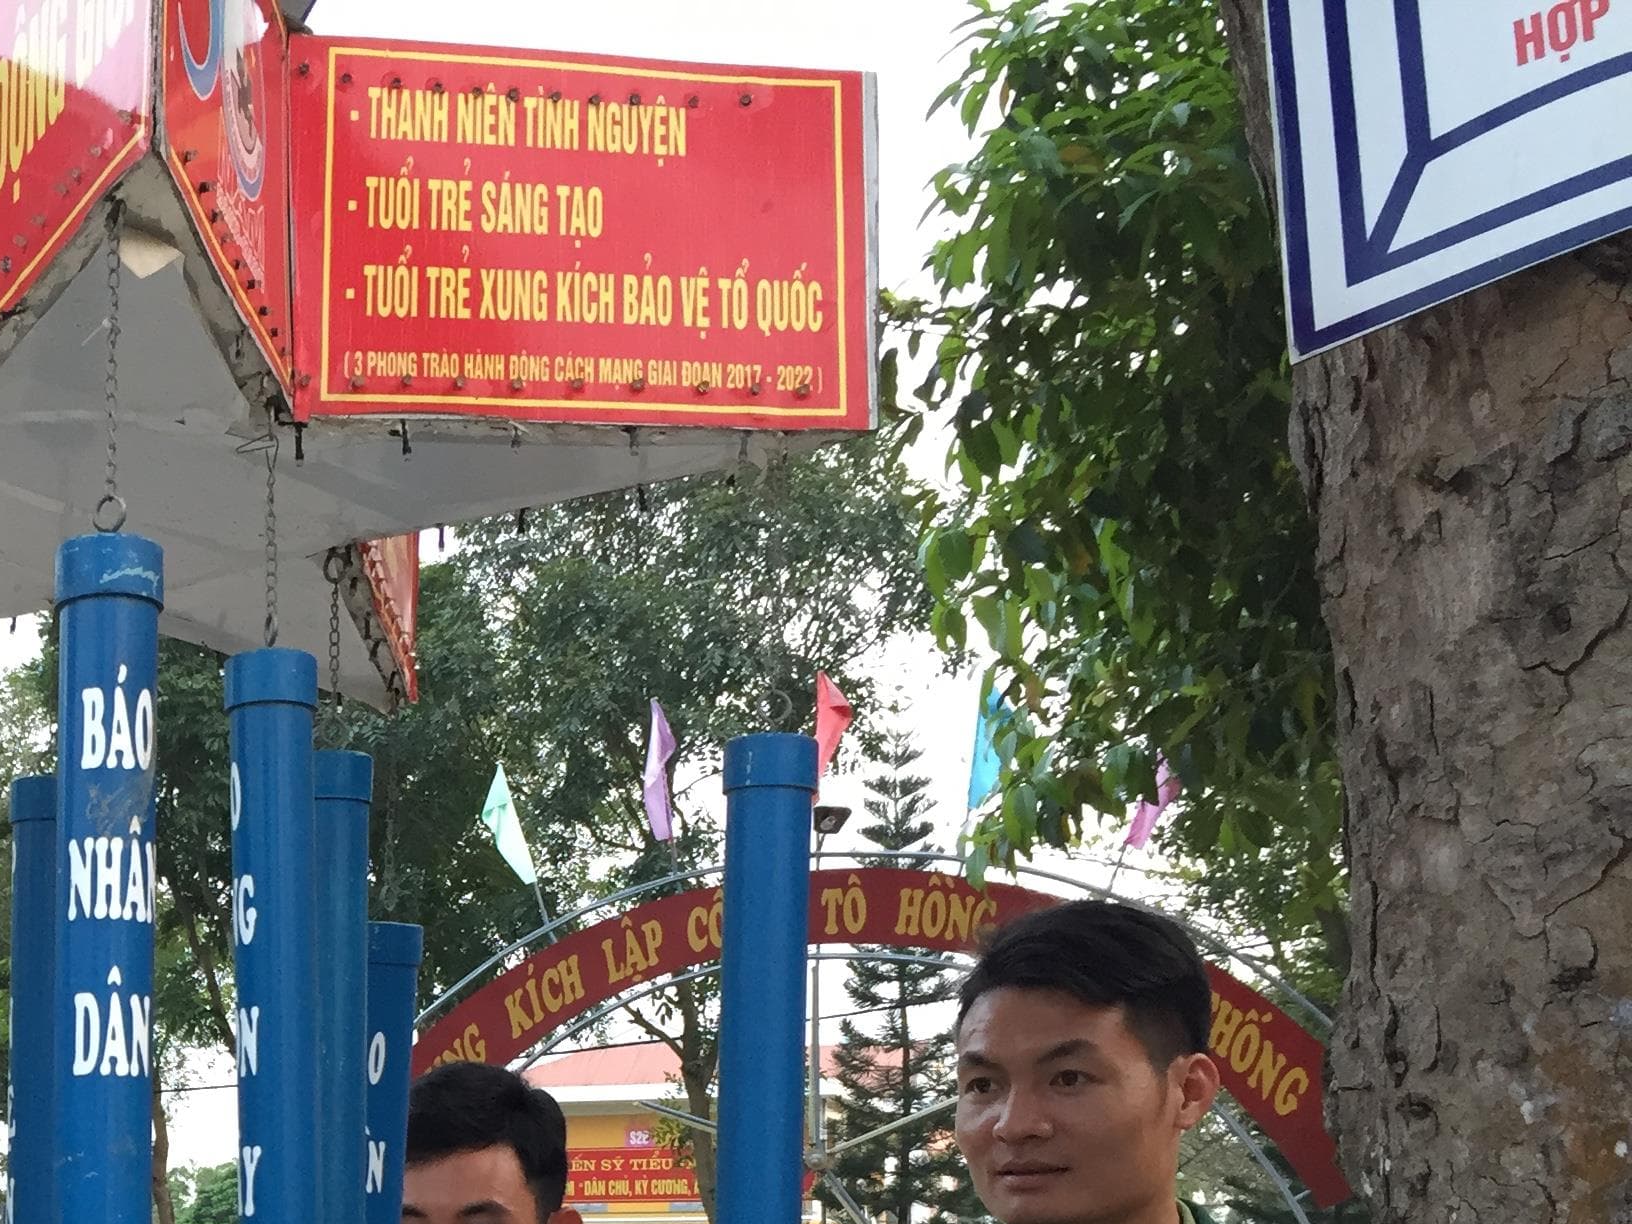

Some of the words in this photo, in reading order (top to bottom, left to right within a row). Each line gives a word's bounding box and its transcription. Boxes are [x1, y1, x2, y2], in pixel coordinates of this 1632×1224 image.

[368, 86, 449, 143] THANH
[457, 82, 516, 146] NIÊN
[524, 85, 580, 151] TÌNH
[587, 95, 687, 168] NGUYỆN
[366, 156, 420, 230] TUỔI
[428, 157, 473, 232] TRẺ
[480, 170, 549, 236] SÁNG
[556, 184, 604, 249] TẠO
[363, 244, 418, 318] TUỔI
[426, 244, 472, 320] TRẺ
[479, 268, 548, 322] XUNG
[556, 261, 615, 324] KÍCH
[623, 252, 673, 326] BẢO
[680, 266, 711, 340] VỆ
[718, 258, 749, 330] TỔ
[756, 262, 824, 337] QUỐC
[368, 351, 418, 377] PHONG
[422, 347, 459, 378] TRÀO
[464, 348, 505, 380] HÀNH
[509, 350, 550, 387] ĐỘNG
[554, 351, 595, 384] CÁCH
[599, 357, 643, 390] MẠNG
[647, 359, 677, 386] GIAI
[726, 363, 762, 389] 2017
[776, 365, 814, 392] 2022
[81, 664, 154, 770] BÁO
[504, 963, 585, 1039] KÍCH
[601, 916, 663, 984] LẬP
[821, 873, 867, 935] TÔ
[894, 874, 998, 944] HỒNG
[73, 965, 150, 1078] DÂN
[629, 1151, 673, 1171] TIỂU
